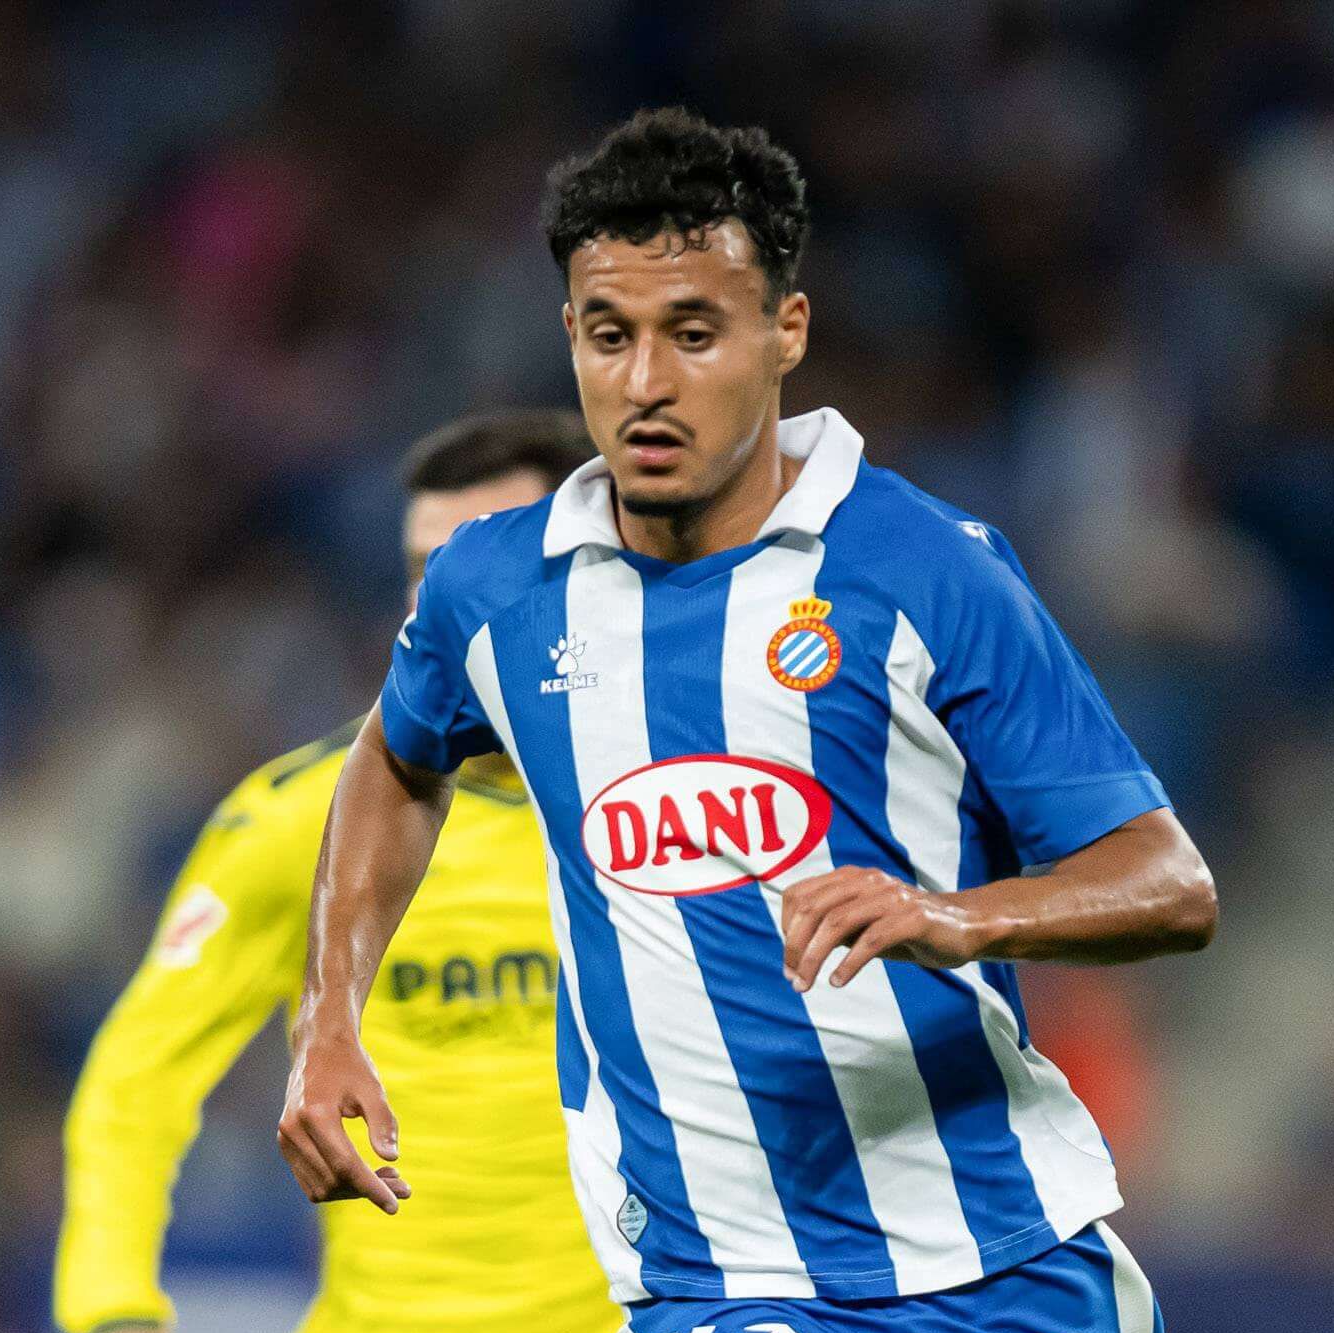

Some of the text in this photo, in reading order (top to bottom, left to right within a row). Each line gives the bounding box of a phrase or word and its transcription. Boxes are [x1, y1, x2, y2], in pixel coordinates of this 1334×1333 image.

[540, 673, 598, 694] KELME
[602, 783, 786, 872] DANI
[392, 952, 556, 1003] PAM
